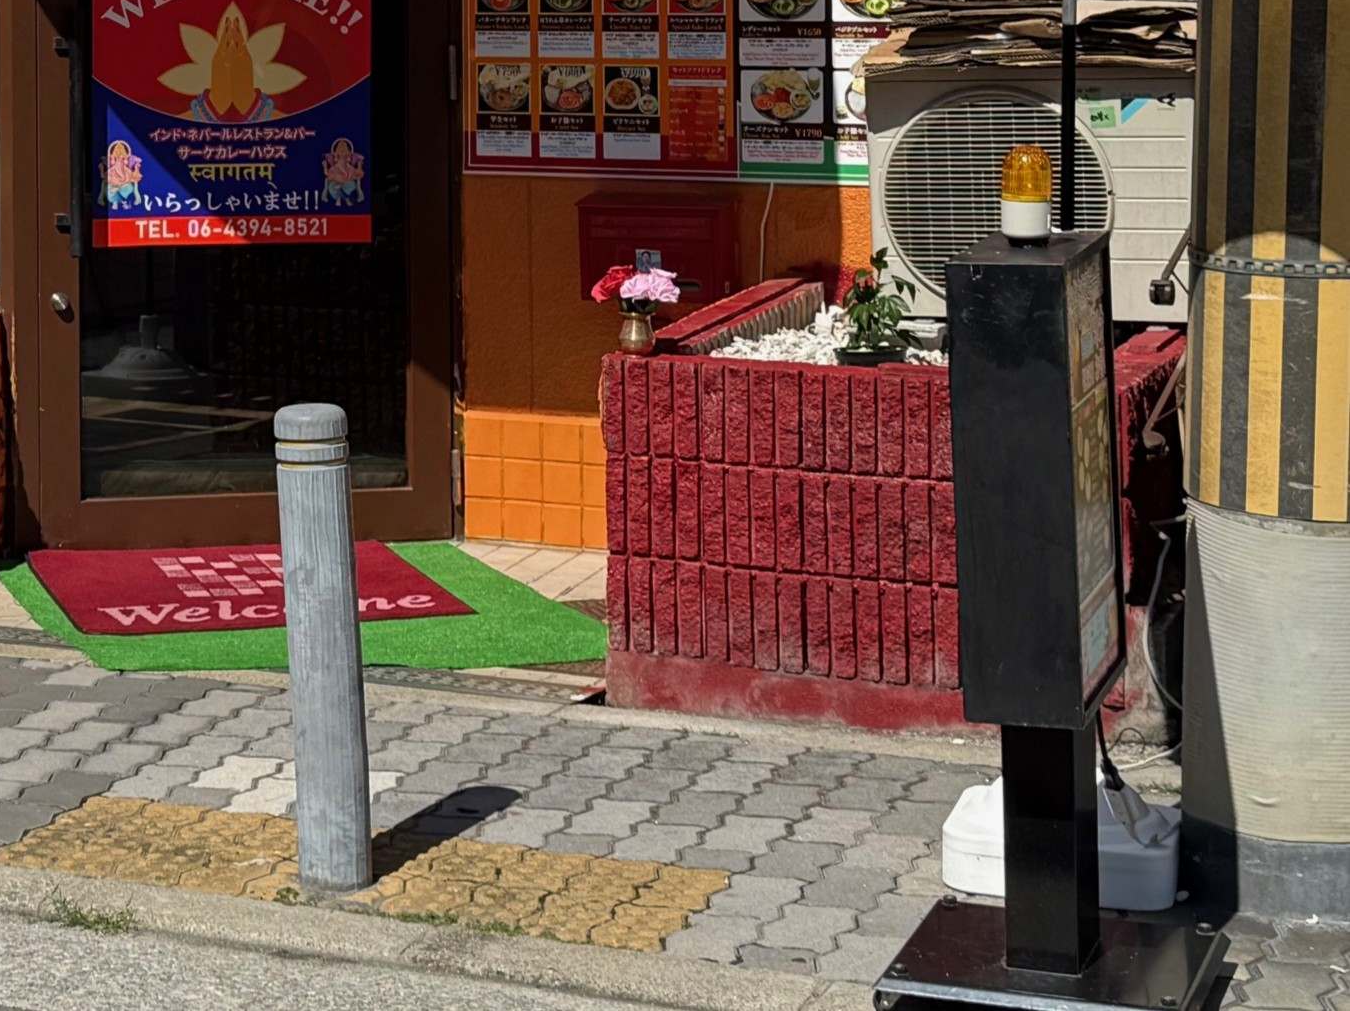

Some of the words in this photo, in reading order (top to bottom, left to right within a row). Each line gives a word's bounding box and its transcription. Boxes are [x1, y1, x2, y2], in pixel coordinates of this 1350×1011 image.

[178, 145, 288, 159] サーケカレーハウス
[144, 190, 319, 212] いらっしゃいませ!!
[135, 220, 181, 239] TEL.
[187, 218, 328, 238] 06-4394-8521
[97, 594, 437, 627] Welcme
